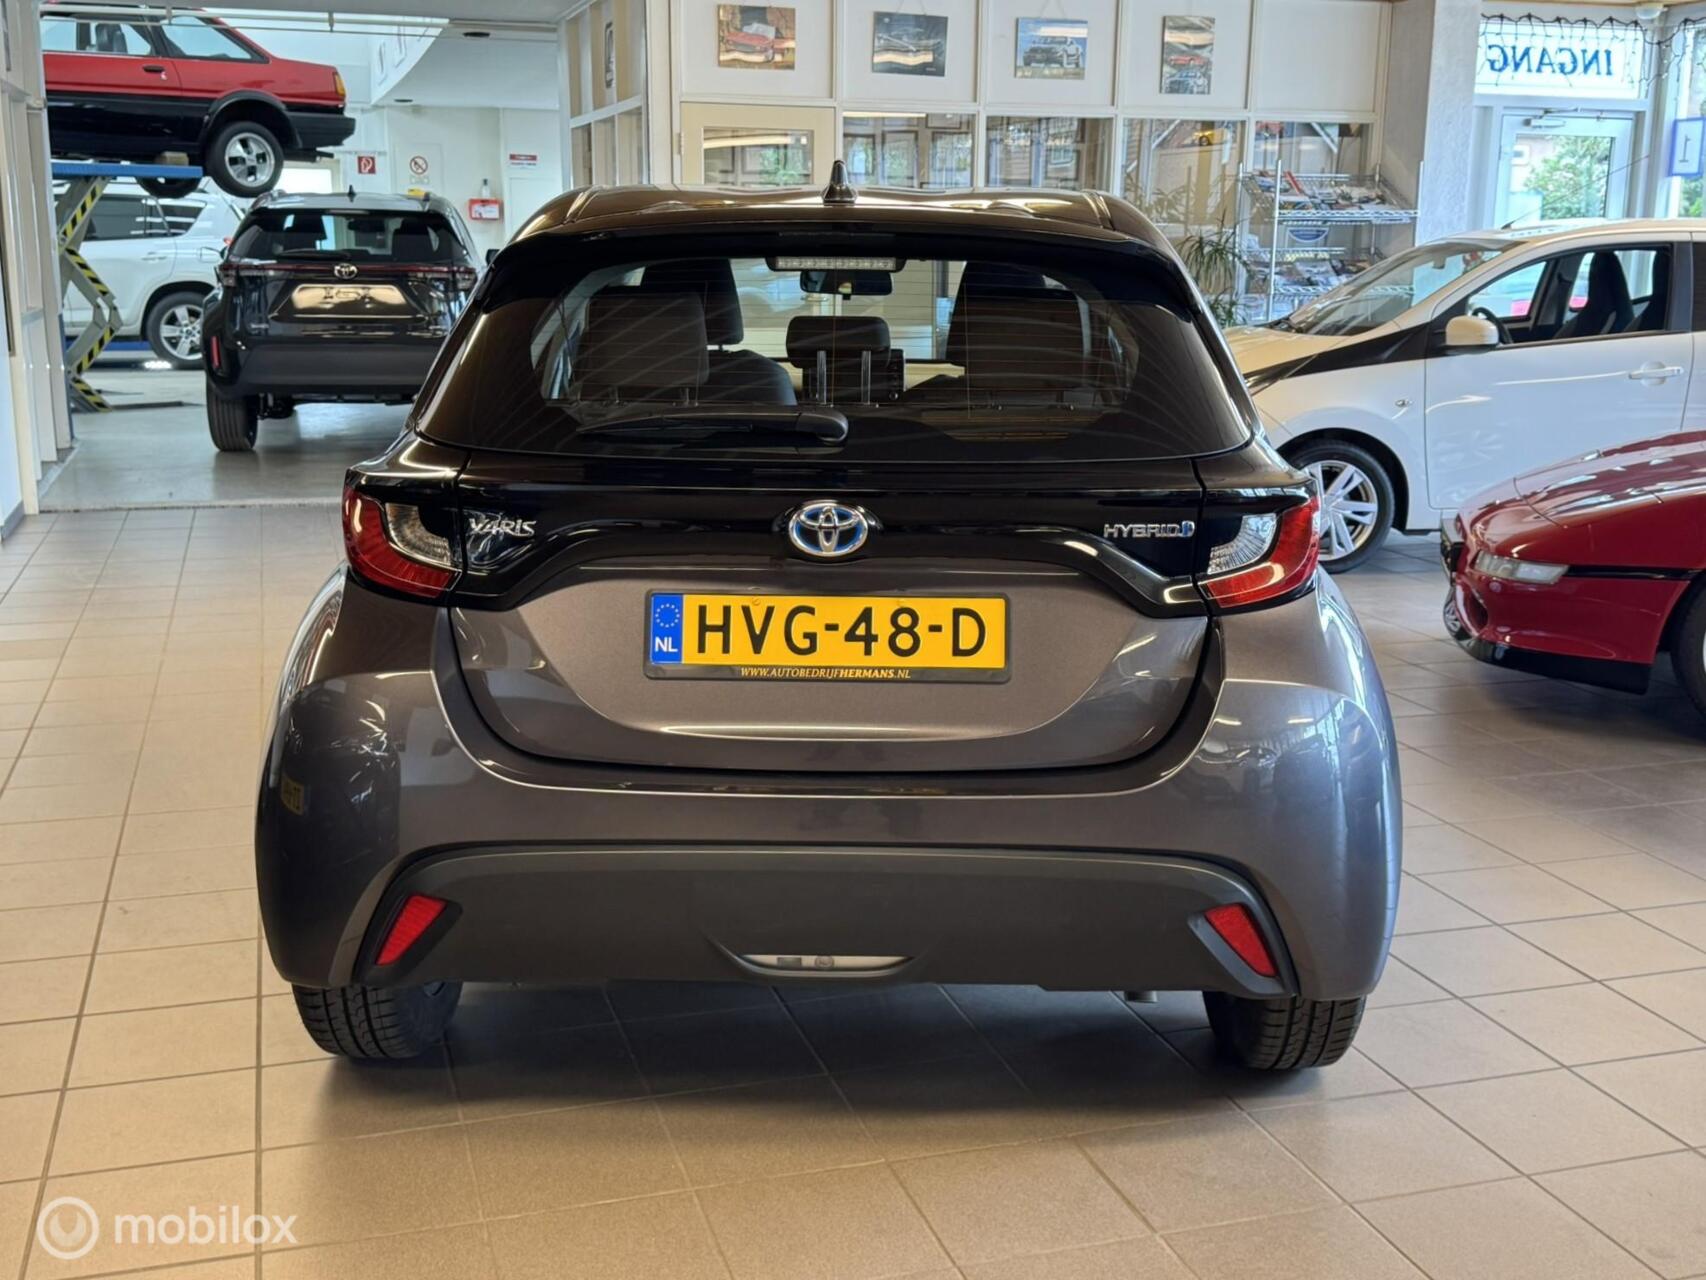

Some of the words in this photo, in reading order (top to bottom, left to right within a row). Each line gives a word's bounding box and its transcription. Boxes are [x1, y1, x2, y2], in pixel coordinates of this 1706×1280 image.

[469, 518, 537, 537] YARIS
[1103, 523, 1180, 538] HYBRID
[697, 604, 986, 658] HVG-48-D
[655, 636, 678, 653] NL
[740, 666, 911, 680] WWW.AUTOBEDRIJFHERMANS.NL
